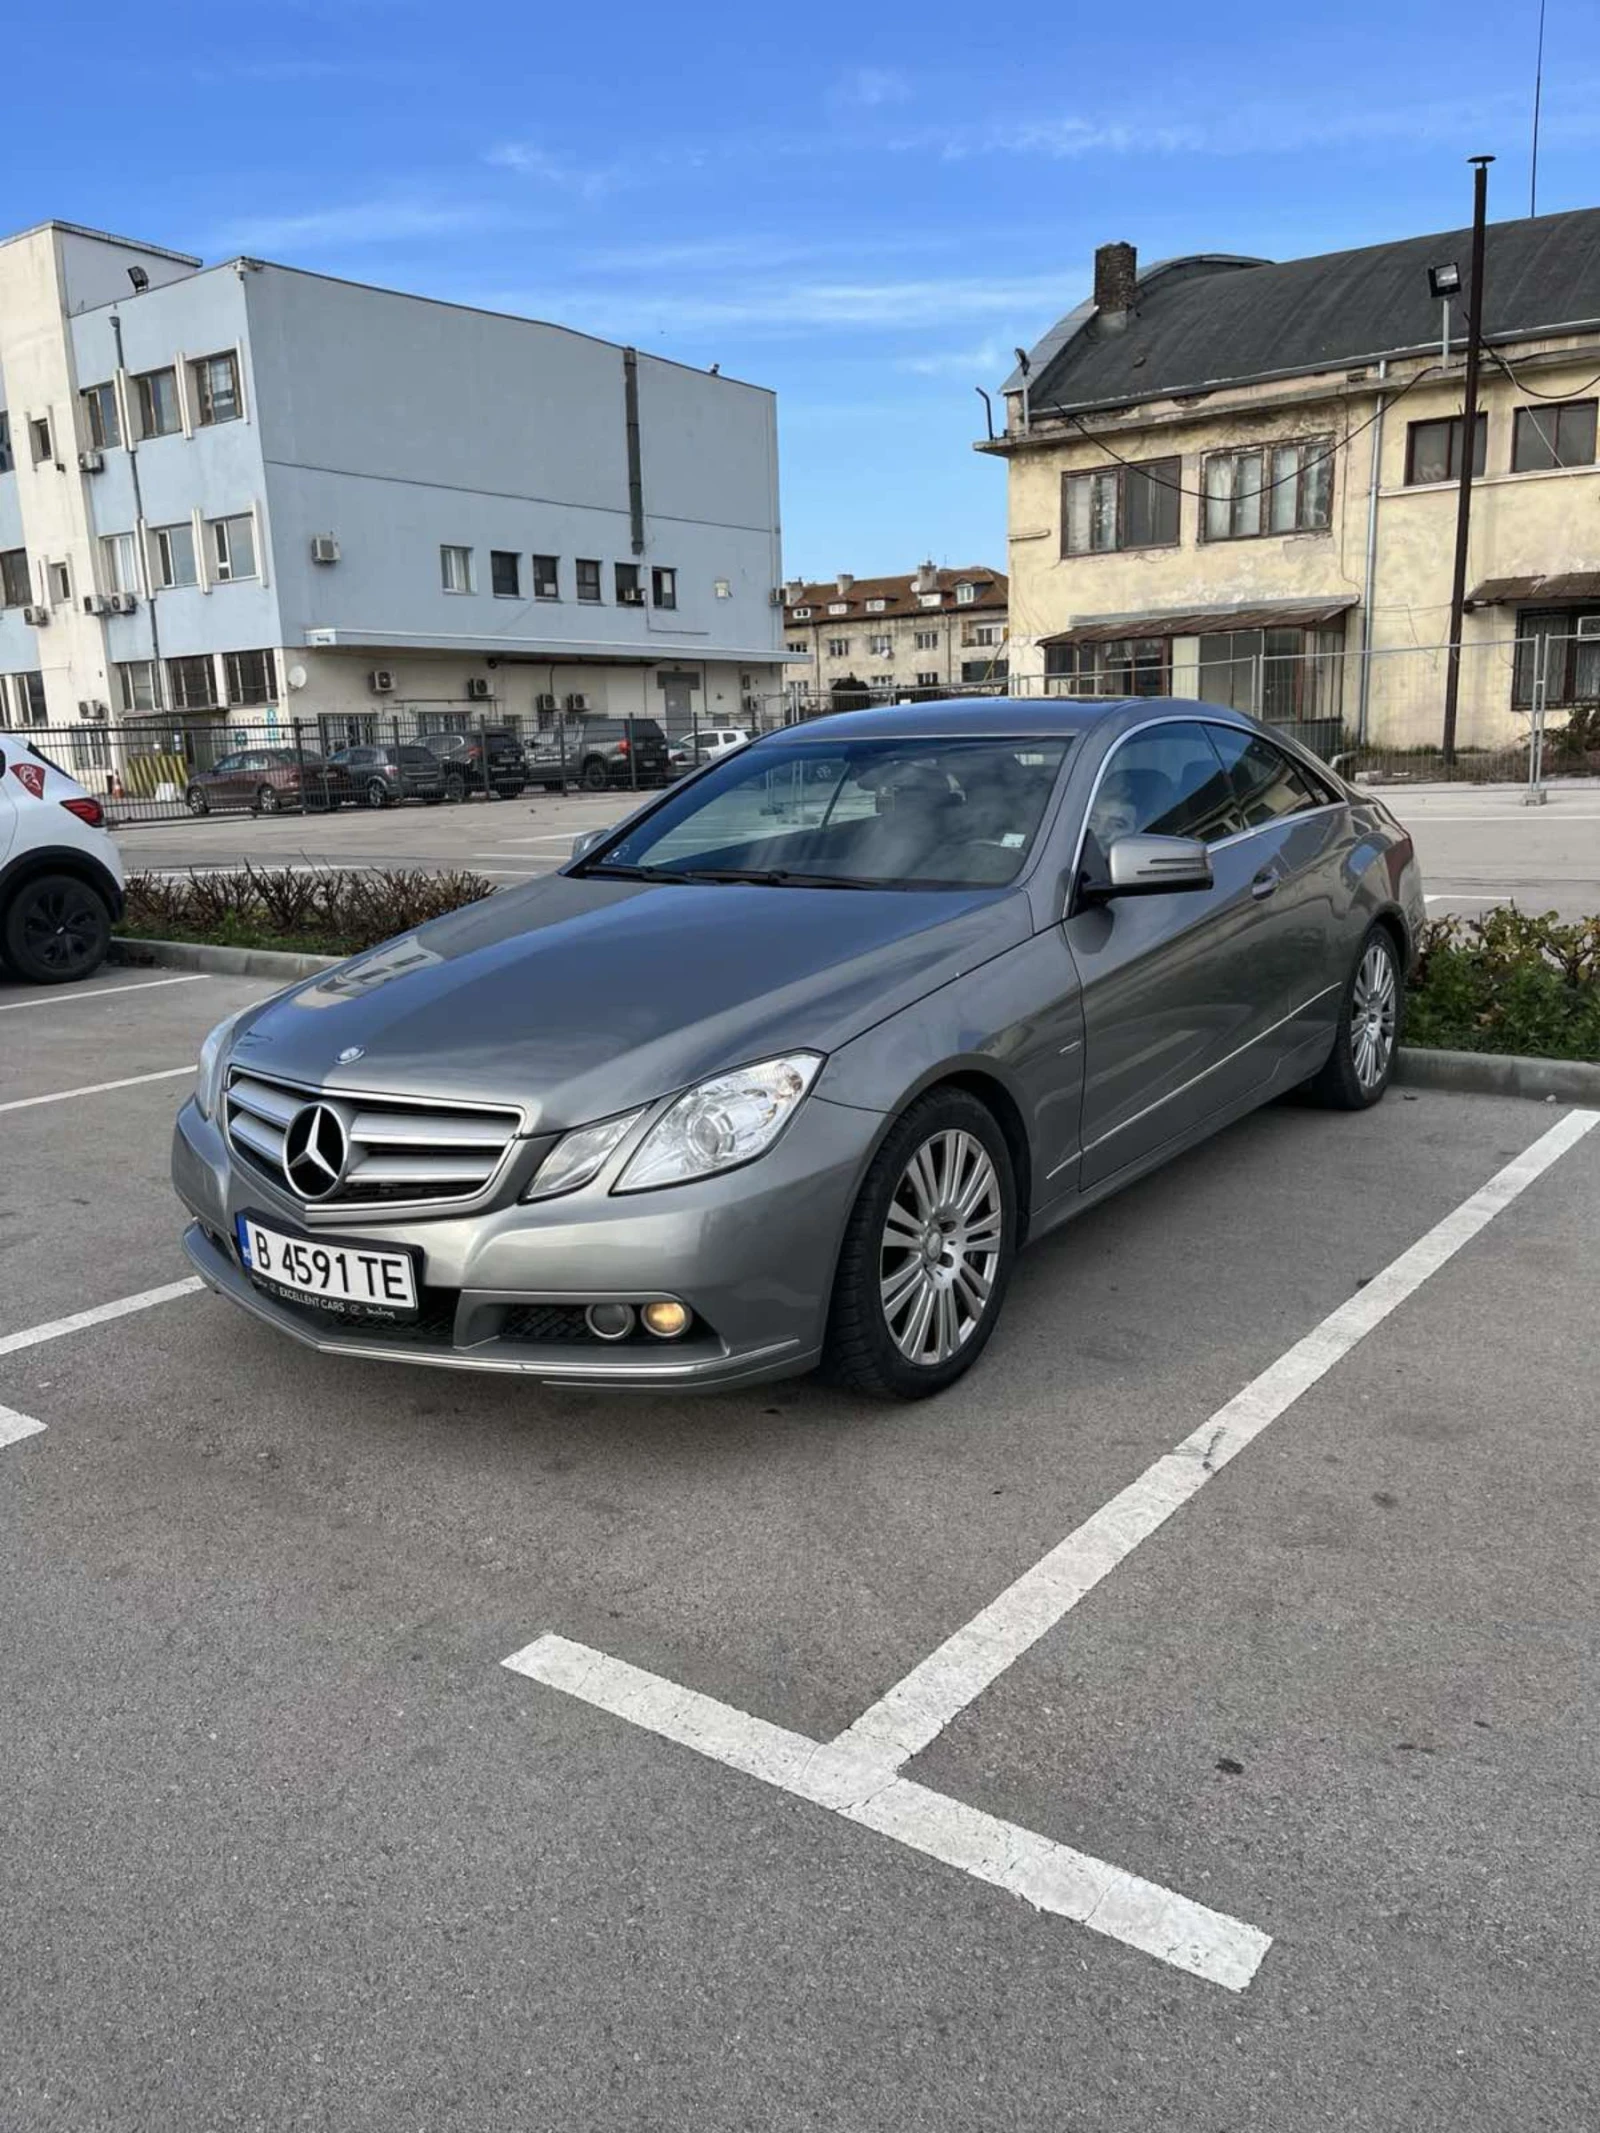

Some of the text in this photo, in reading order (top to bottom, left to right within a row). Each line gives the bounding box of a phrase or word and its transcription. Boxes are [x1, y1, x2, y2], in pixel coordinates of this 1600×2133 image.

[255, 1231, 408, 1300] B 4591 TE
[279, 1286, 345, 1313] EXCELLENT CARS
